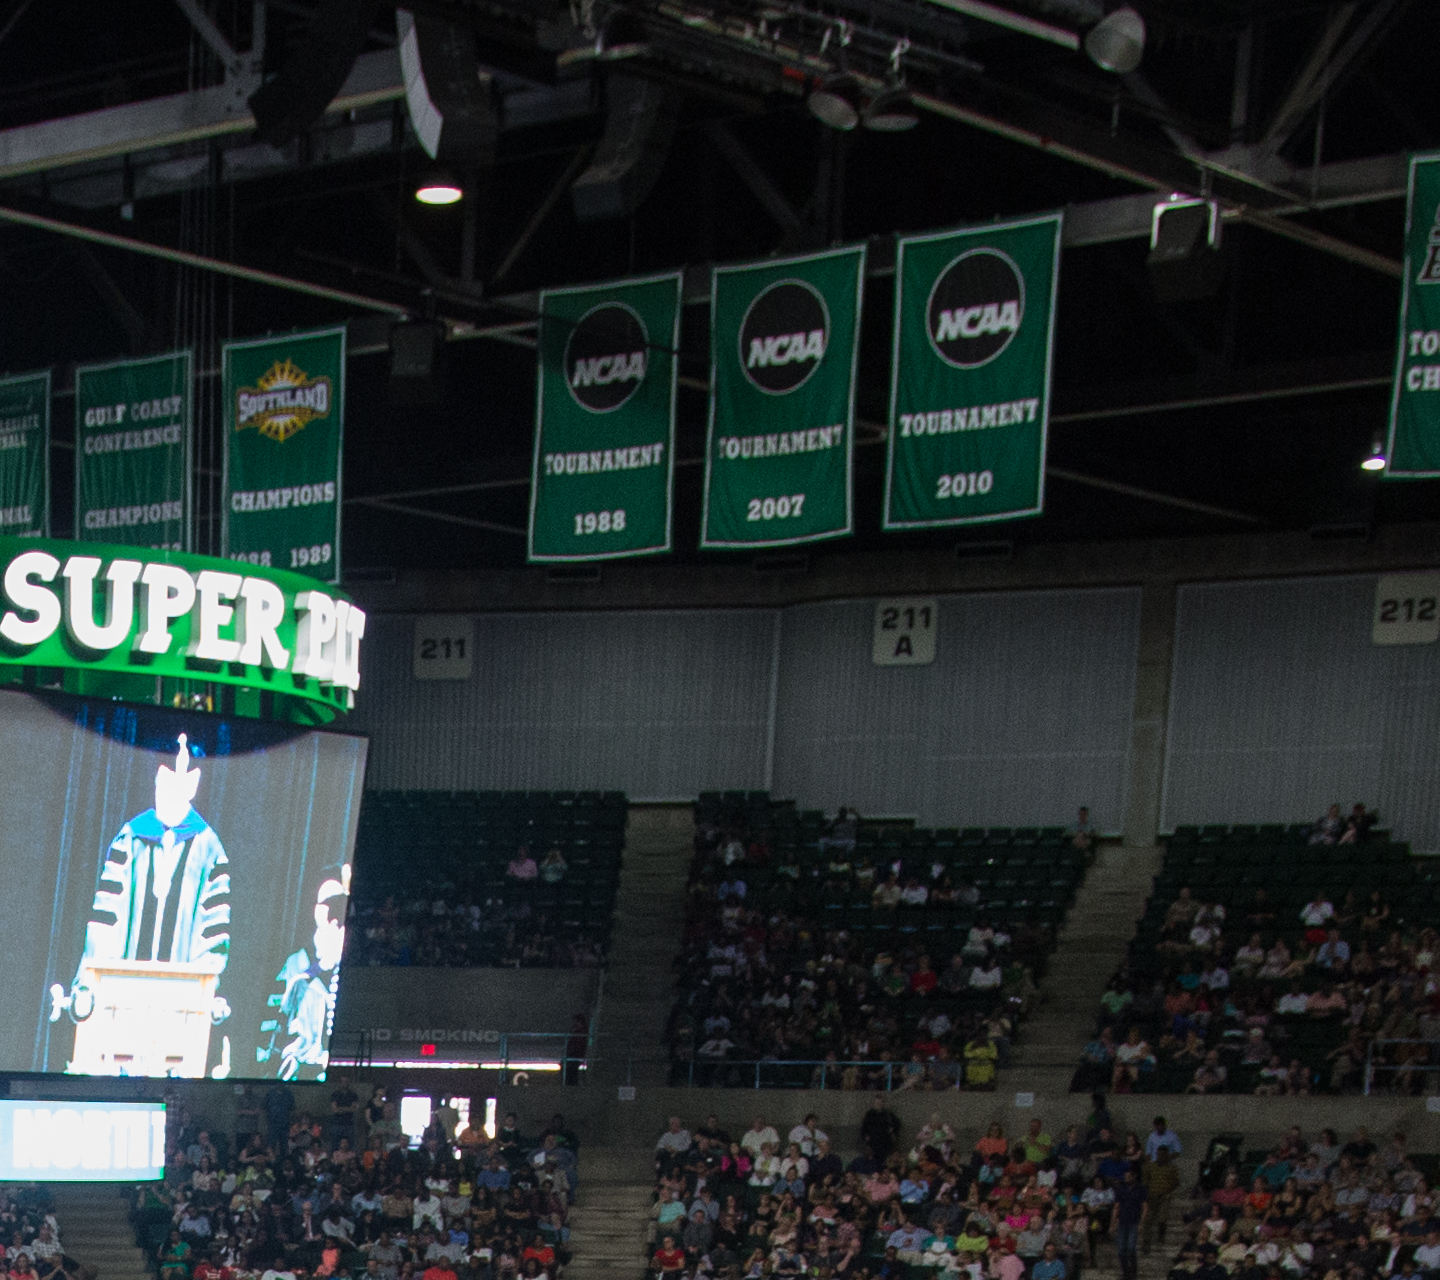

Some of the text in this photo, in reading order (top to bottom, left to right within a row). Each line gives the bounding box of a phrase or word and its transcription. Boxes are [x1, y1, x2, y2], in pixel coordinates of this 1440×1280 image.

[935, 300, 1019, 342] NCAA
[747, 329, 825, 369] NCAA
[573, 351, 646, 388] NCAA
[84, 395, 182, 428] GULF COAST
[238, 384, 329, 421] SOUTHLAND
[899, 398, 1040, 437] TOURNAMENT
[84, 425, 182, 455] CONFERENCE
[718, 424, 844, 460] TOURNAMENT
[545, 443, 665, 475] TOURNAMENT
[231, 481, 335, 513] CHAMPIONS
[935, 470, 993, 499] 2010
[84, 500, 182, 530] CHAMPIONS
[747, 494, 805, 521] 2007
[574, 510, 627, 536] 1988
[291, 544, 332, 568] 1989
[0, 551, 290, 673] SUPER
[881, 606, 933, 630] 211
[1381, 597, 1436, 623] 212
[420, 639, 466, 661] 211
[894, 637, 914, 658] A
[400, 1028, 500, 1042] SMOKING
